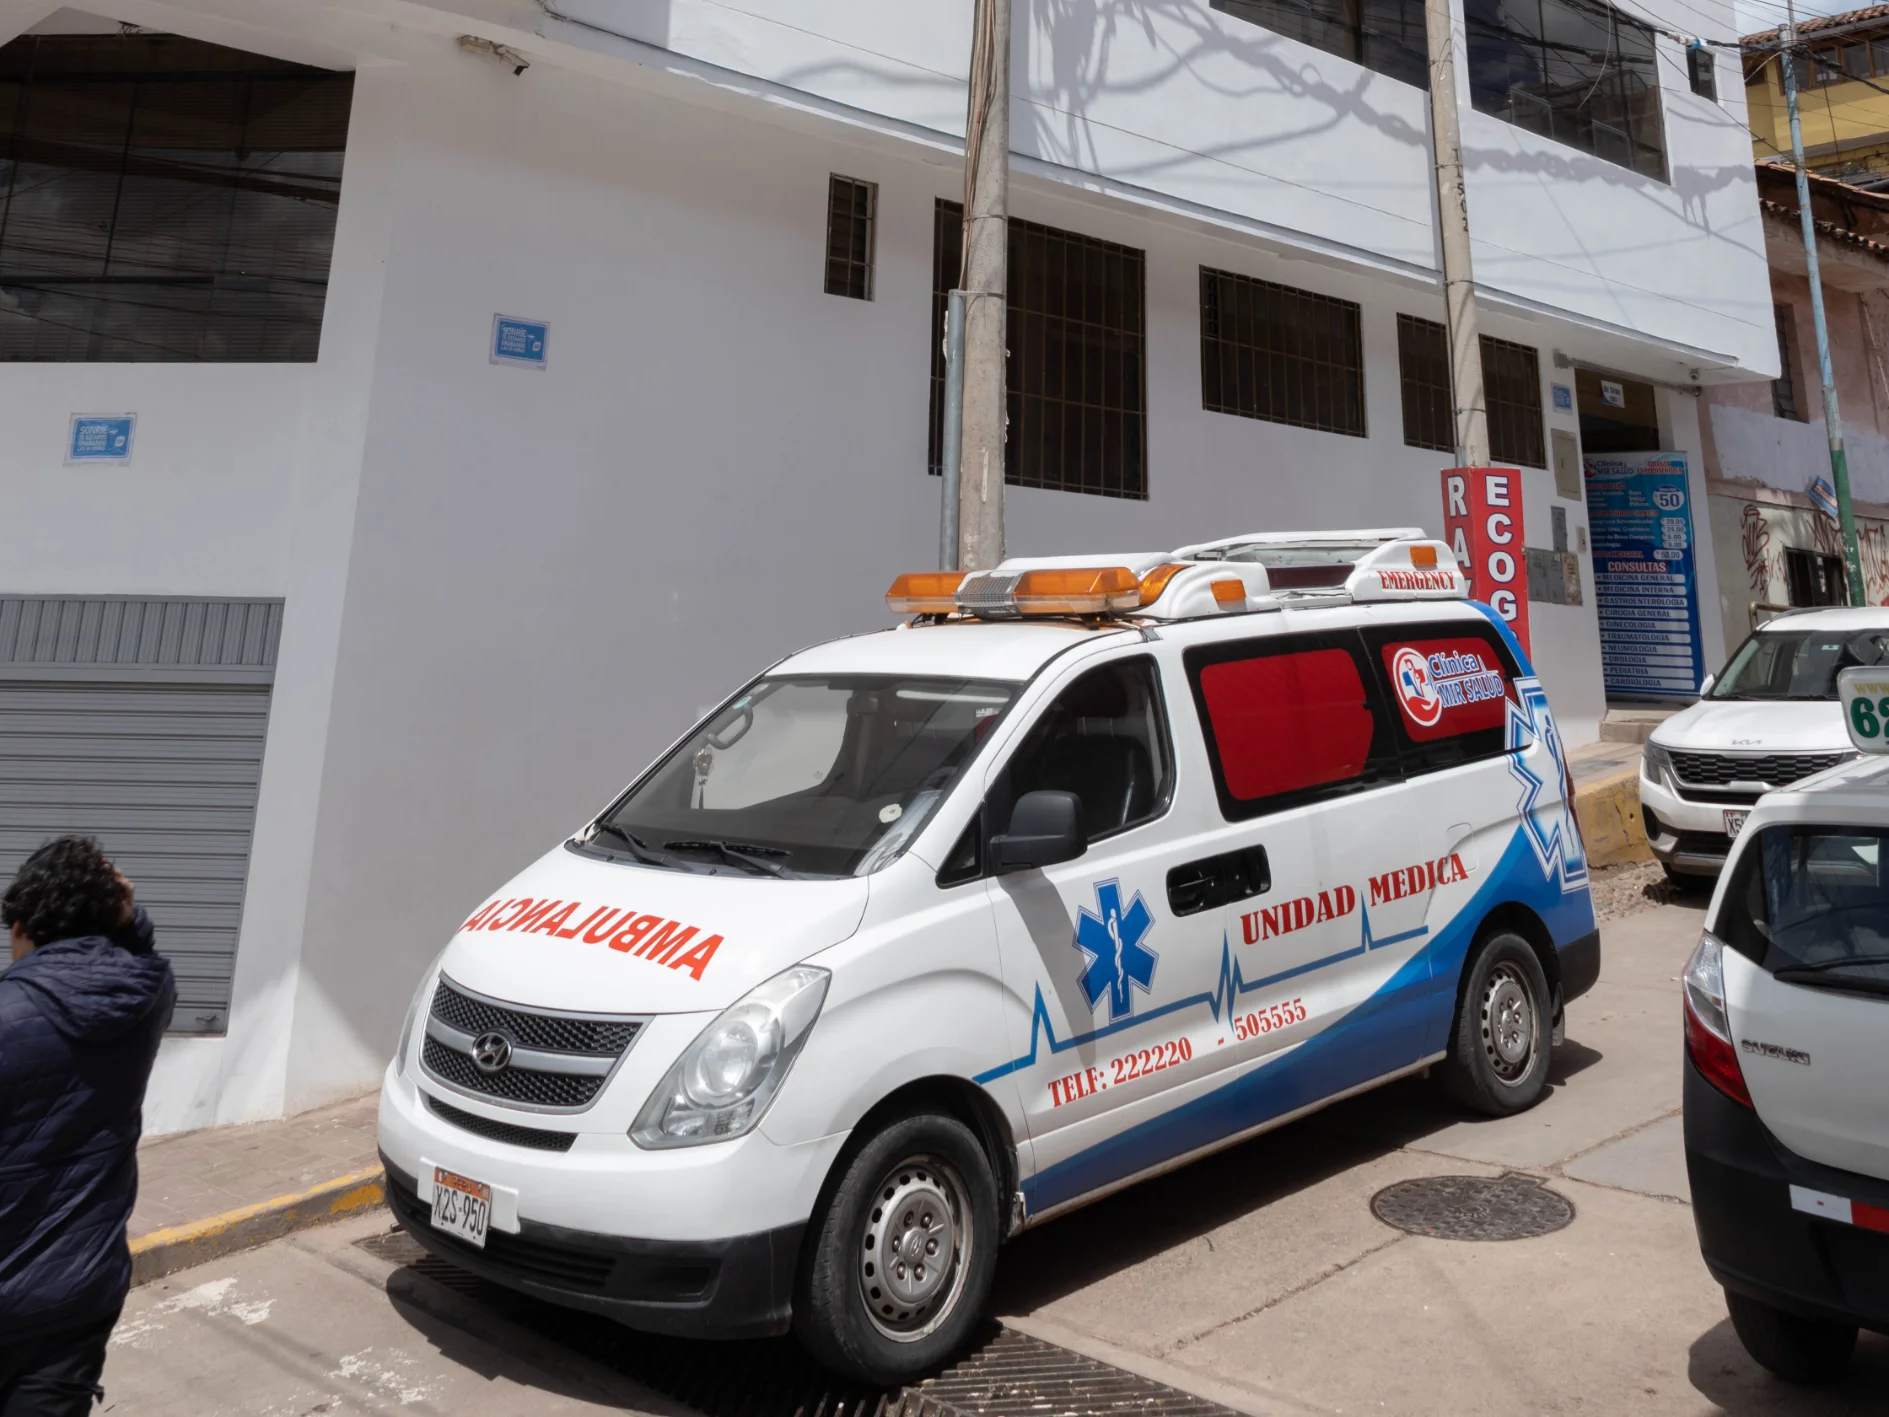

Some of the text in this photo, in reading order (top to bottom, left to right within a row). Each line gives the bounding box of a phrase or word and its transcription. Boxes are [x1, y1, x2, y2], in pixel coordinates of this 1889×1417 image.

[1612, 467, 1635, 475] SALUD
[1659, 493, 1680, 507] 50
[1485, 475, 1517, 638] ECOG
[1608, 562, 1667, 572] CONSULTAS
[1376, 570, 1456, 590] EMERGENCY
[1606, 621, 1656, 629] GINECOLOGIA
[1607, 633, 1670, 641] TRAUMATOLOGIA
[1608, 645, 1657, 653] NEUMOLOGIA
[1428, 651, 1479, 677] Clínica
[1609, 655, 1647, 663] UROLOGIA
[1610, 667, 1649, 675] PEDIATRIA
[1610, 678, 1661, 686] CARDIOLOGIA
[1438, 674, 1504, 707] MIR SALUD
[1728, 818, 1744, 834] X5
[1240, 852, 1469, 945] UNIDAD MEDICA
[1048, 1066, 1107, 1108] TELF:
[1110, 1036, 1193, 1085] 222220
[1234, 997, 1307, 1041] 505555
[1741, 1039, 1811, 1065] SUZUKI
[434, 1184, 486, 1236] X2S-950
